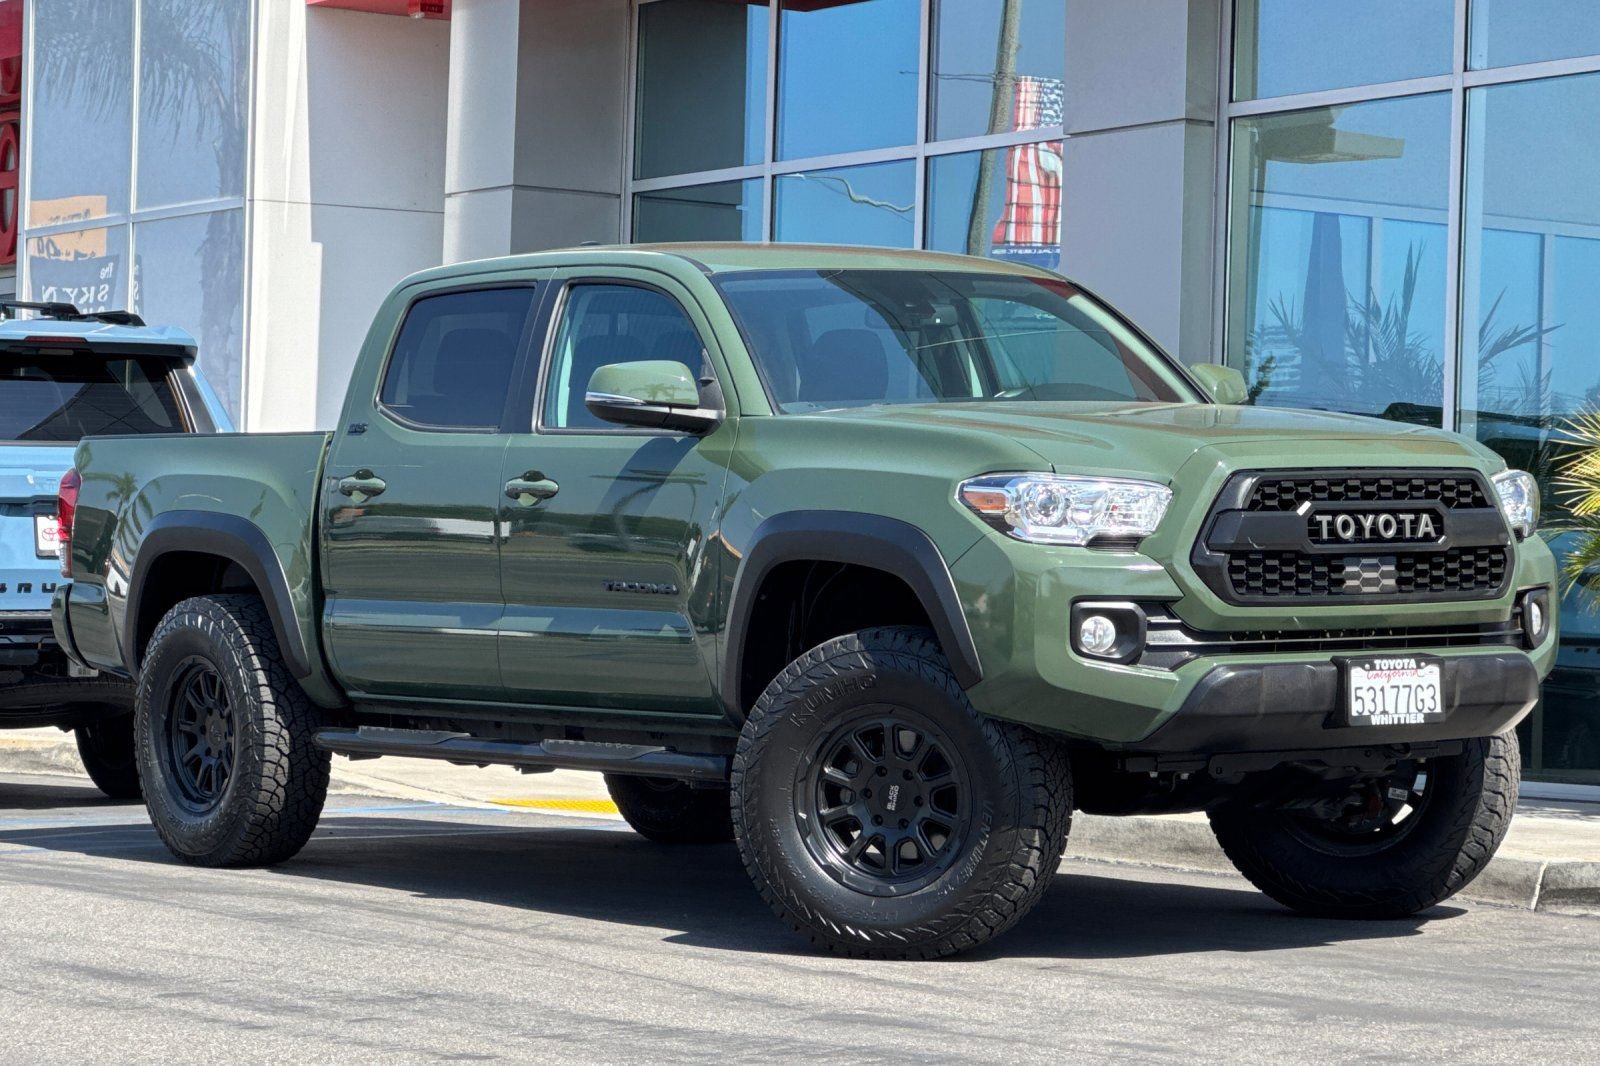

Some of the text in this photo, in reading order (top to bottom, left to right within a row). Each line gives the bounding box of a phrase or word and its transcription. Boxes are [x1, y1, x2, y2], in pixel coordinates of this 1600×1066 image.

[1315, 513, 1437, 540] TOYOTA
[1374, 658, 1417, 670] TOYOTA
[1366, 669, 1422, 683] California
[1354, 683, 1437, 715] 53177G3
[1370, 713, 1425, 726] WHITTIER
[886, 785, 895, 810] BLACK
